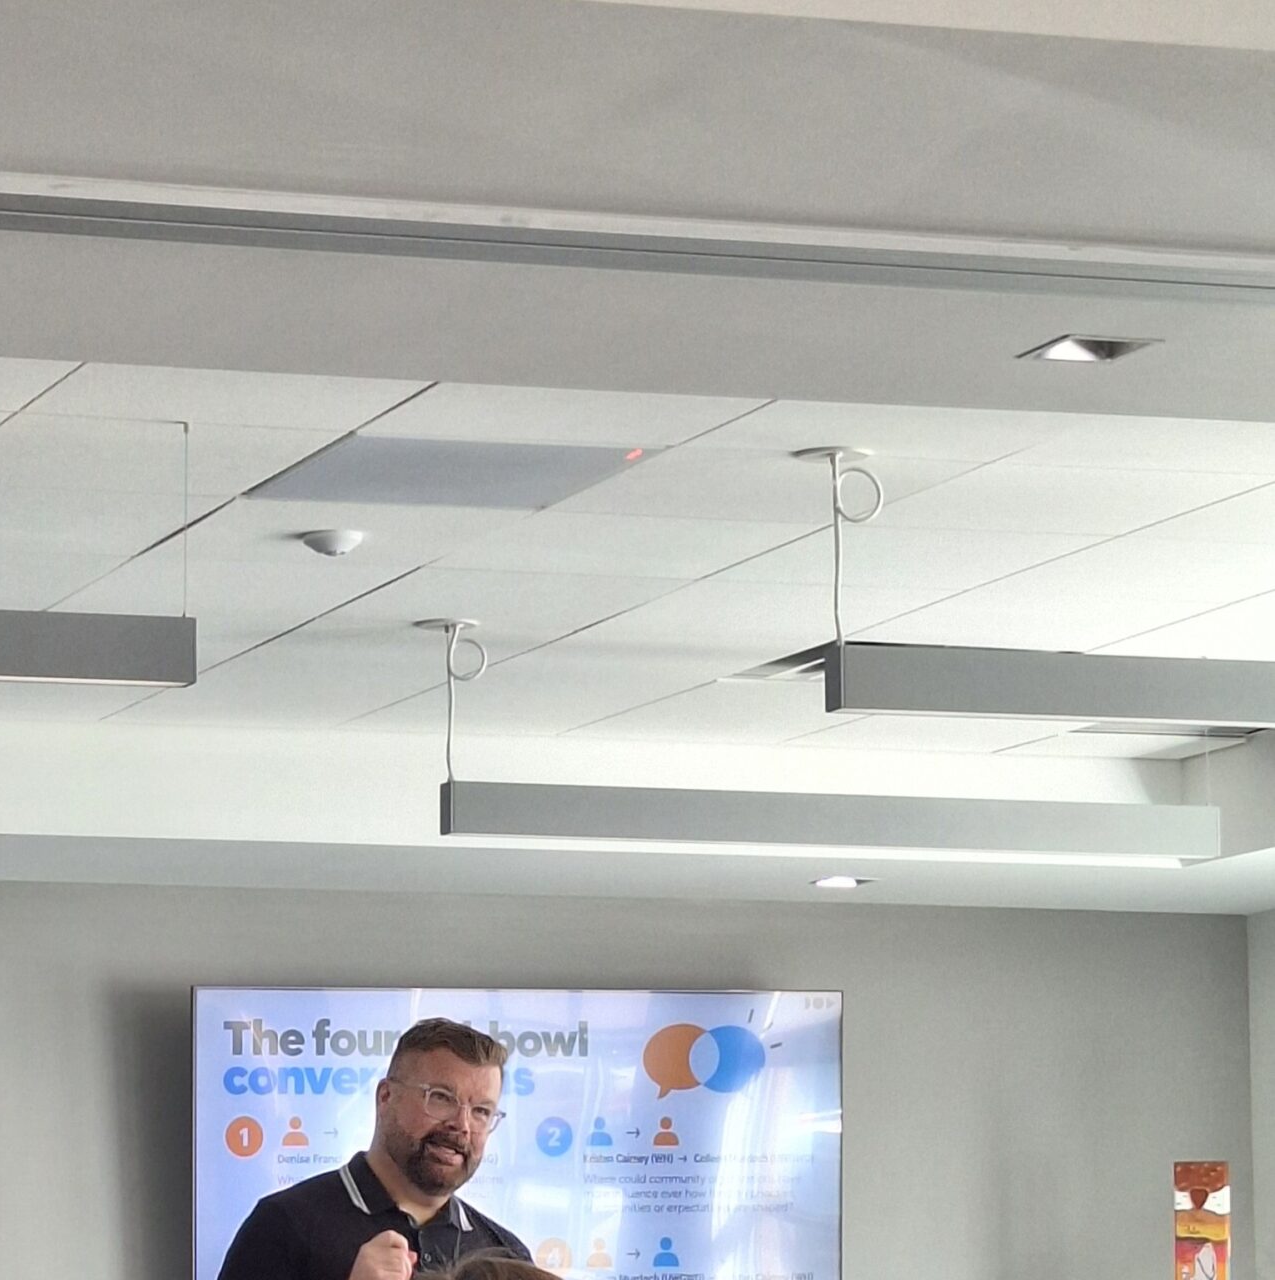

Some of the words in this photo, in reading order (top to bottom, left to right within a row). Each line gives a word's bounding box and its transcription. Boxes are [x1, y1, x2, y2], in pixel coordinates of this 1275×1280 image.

[224, 1019, 304, 1056] The
[312, 1018, 401, 1056] four
[239, 1127, 249, 1147] 1
[548, 1129, 561, 1148] 2
[618, 1174, 646, 1184] could
[648, 1174, 705, 1187] community
